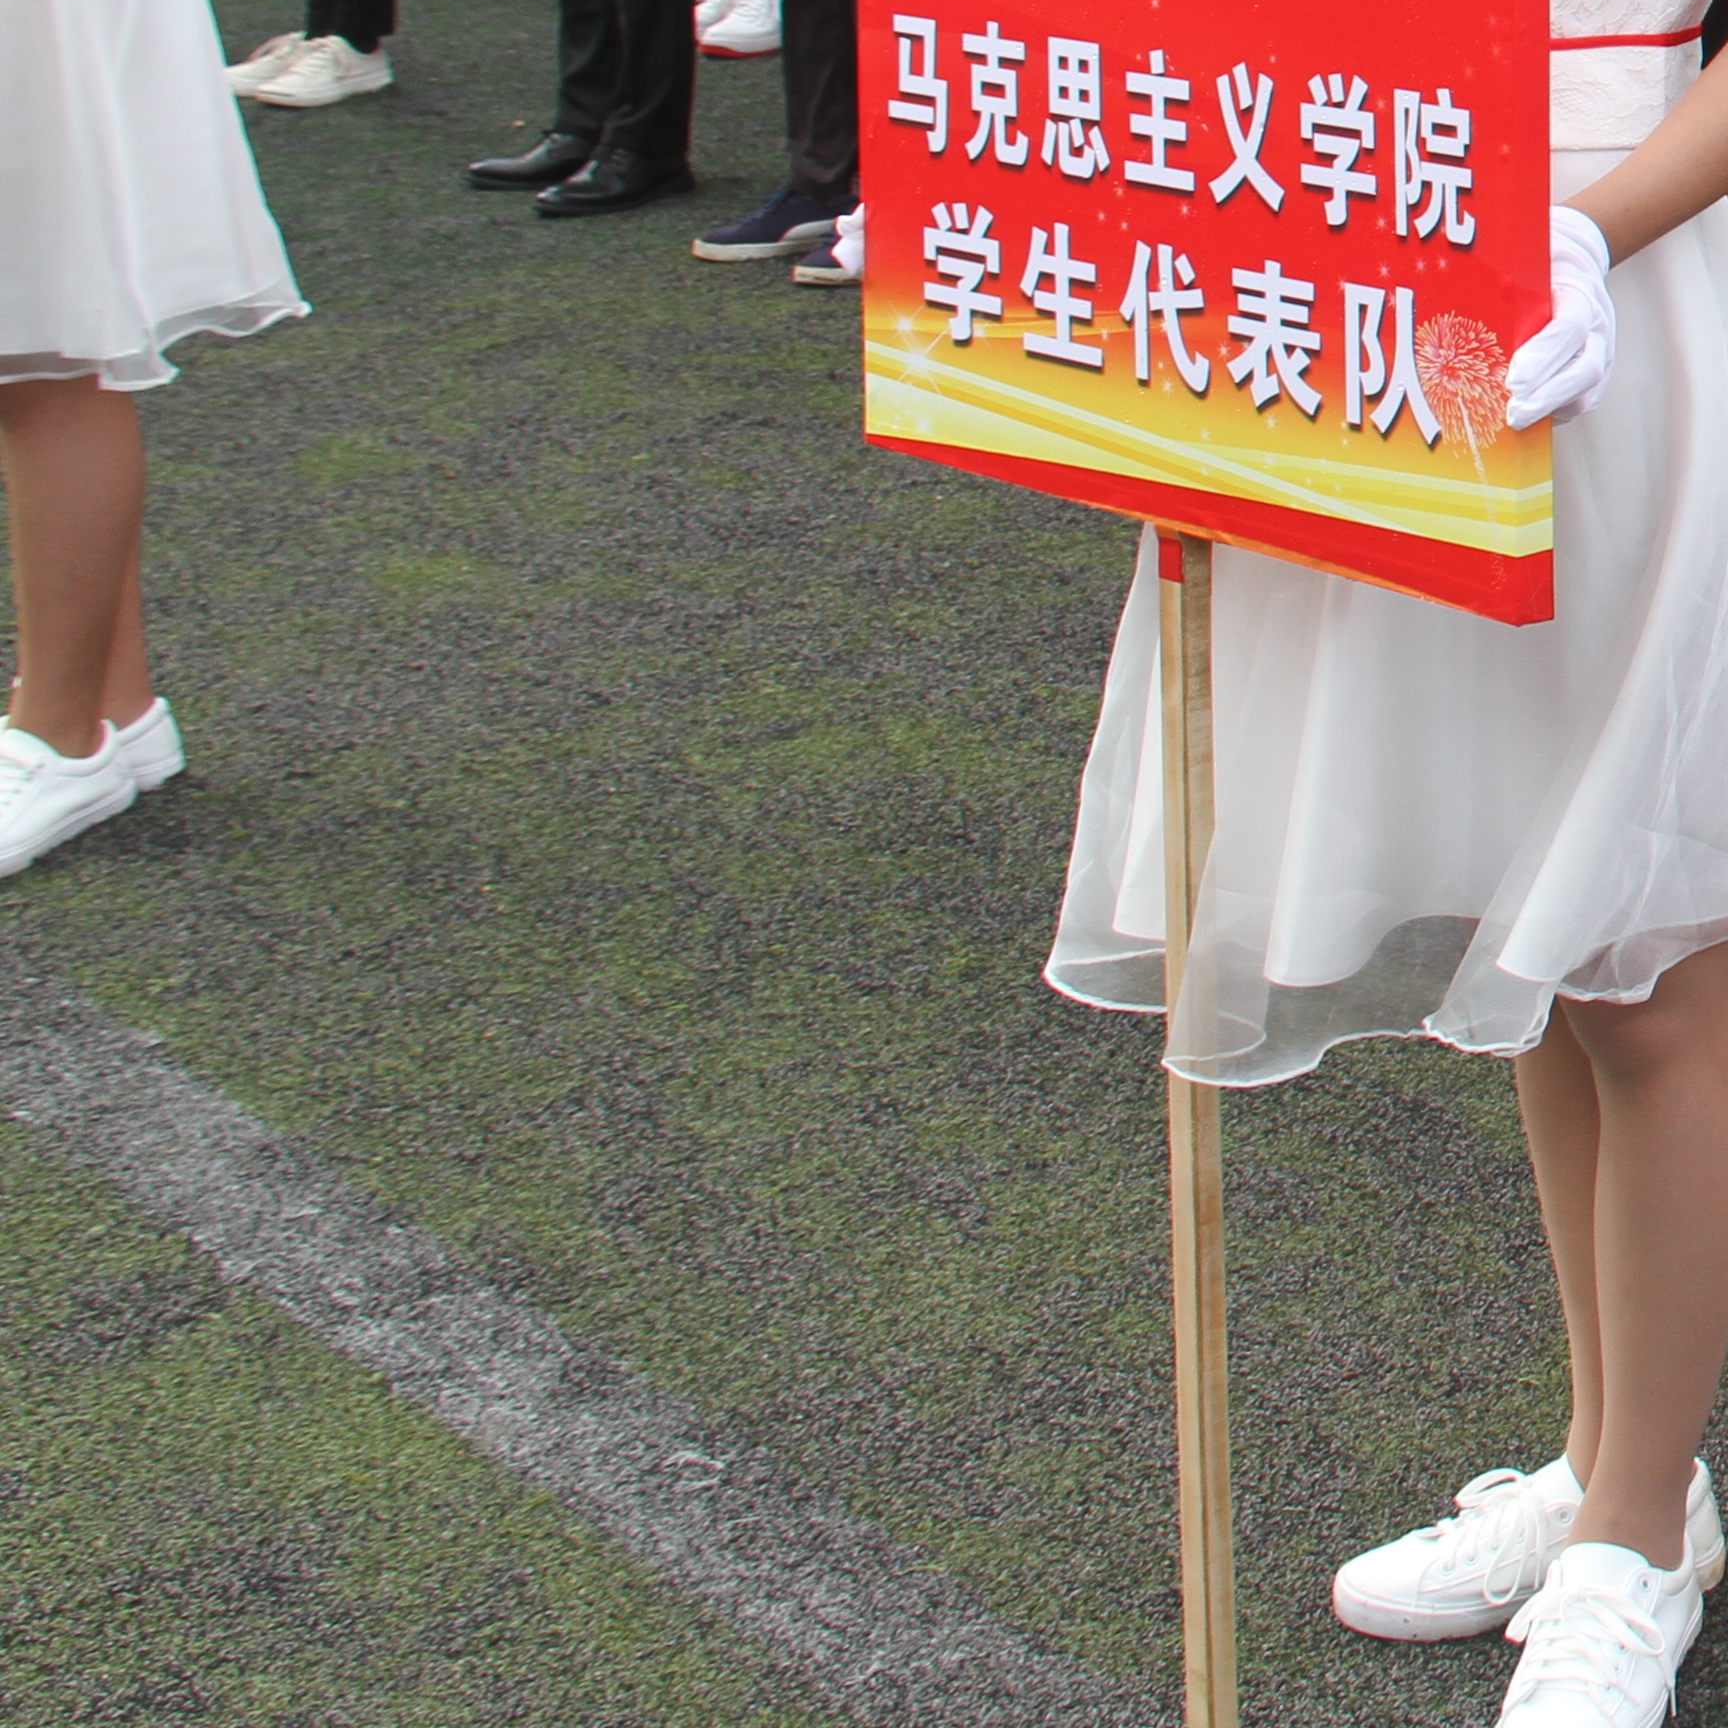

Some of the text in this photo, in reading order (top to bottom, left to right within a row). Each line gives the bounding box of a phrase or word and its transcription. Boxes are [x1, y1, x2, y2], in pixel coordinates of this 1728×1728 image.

[888, 13, 1477, 247] 马克思主义学院
[923, 203, 1443, 446] 学生代表队
